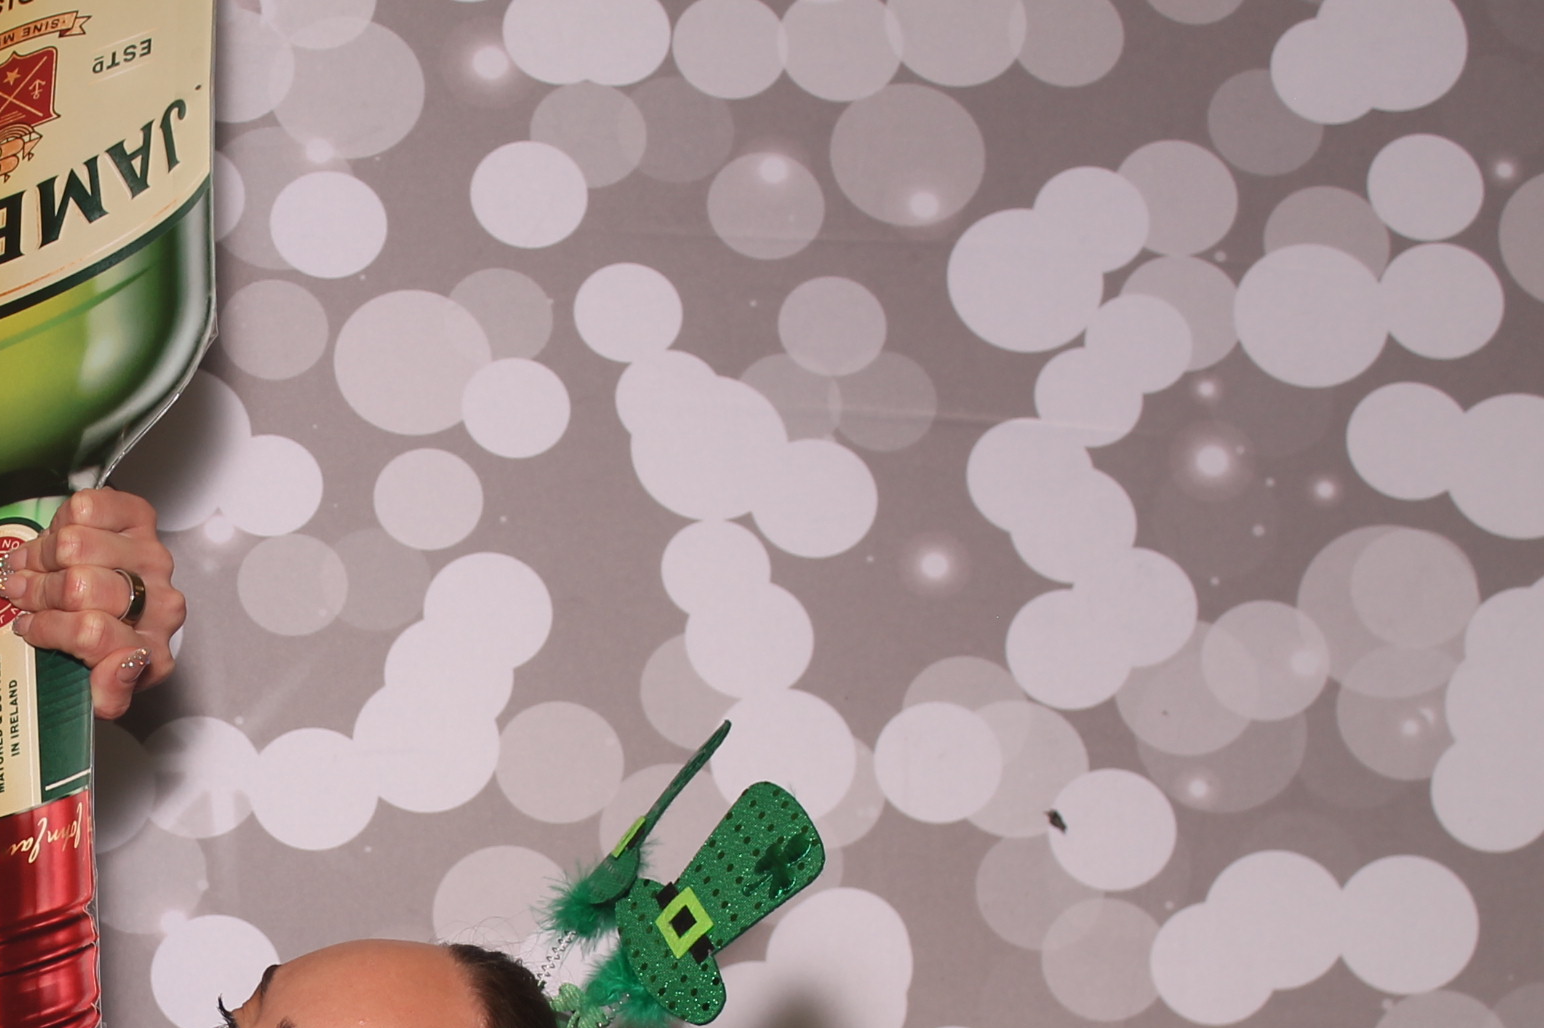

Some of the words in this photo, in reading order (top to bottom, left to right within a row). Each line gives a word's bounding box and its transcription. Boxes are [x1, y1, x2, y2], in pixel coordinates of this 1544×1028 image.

[22, 16, 61, 38] SINE
[8, 679, 20, 740] IRELAND
[10, 743, 21, 758] IN
